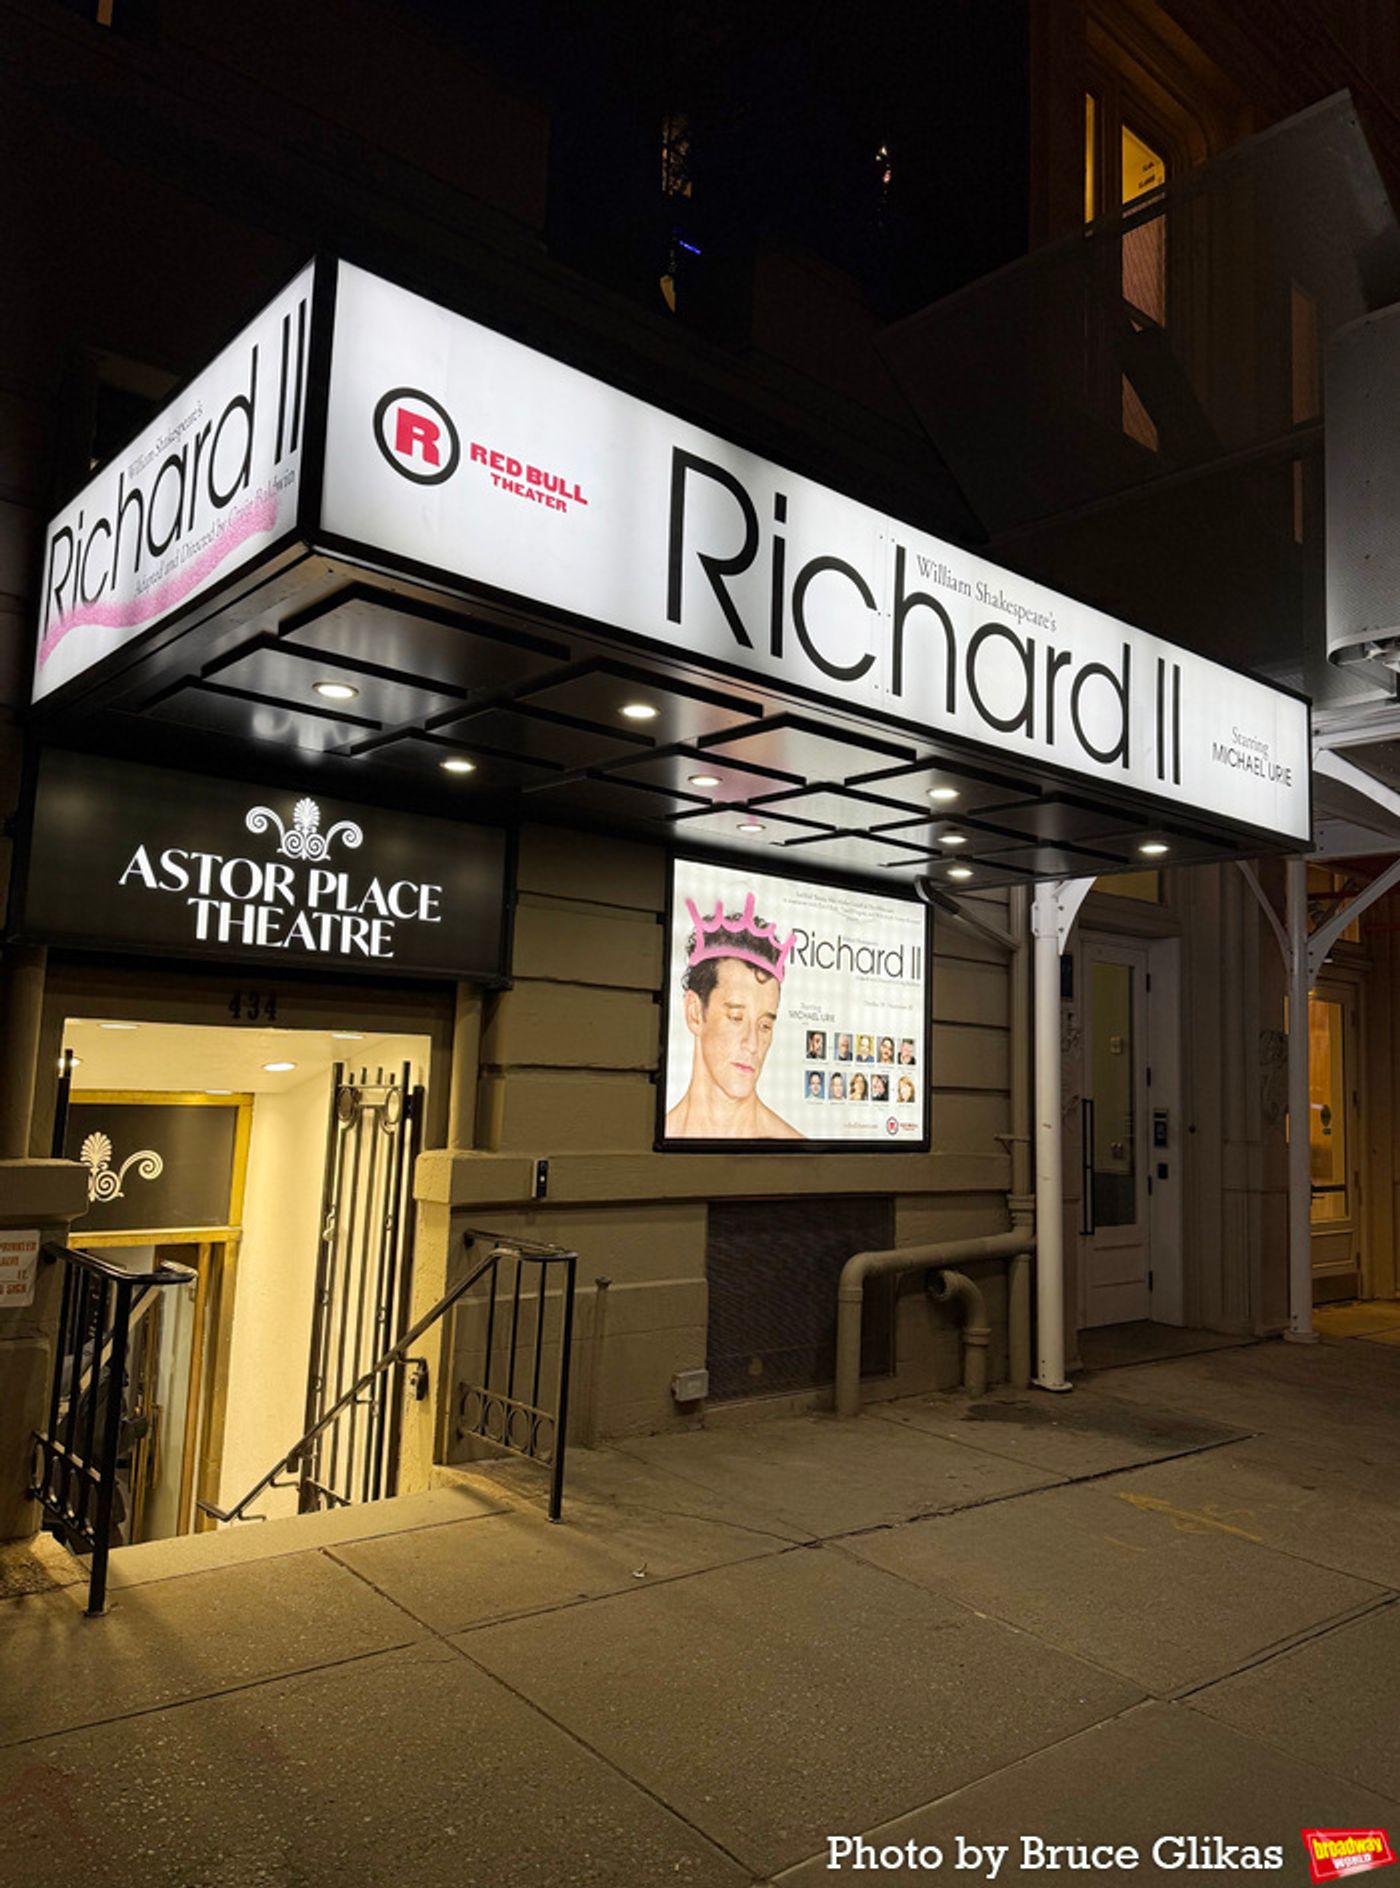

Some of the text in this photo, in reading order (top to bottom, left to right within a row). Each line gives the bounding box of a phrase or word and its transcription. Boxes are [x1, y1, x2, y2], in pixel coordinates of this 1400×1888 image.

[396, 408, 441, 466] R
[43, 298, 307, 640] Richard II
[470, 442, 588, 505] RED BULL
[490, 472, 567, 513] THEATER
[667, 446, 1181, 786] Richard II
[916, 554, 1057, 632] William Shakespeare's
[1212, 742, 1291, 787] MICHAEL URIE
[118, 844, 442, 922] ASTOR PLACE
[187, 897, 395, 958] THEATRE
[789, 927, 904, 978] Richard
[228, 989, 278, 1021] 434
